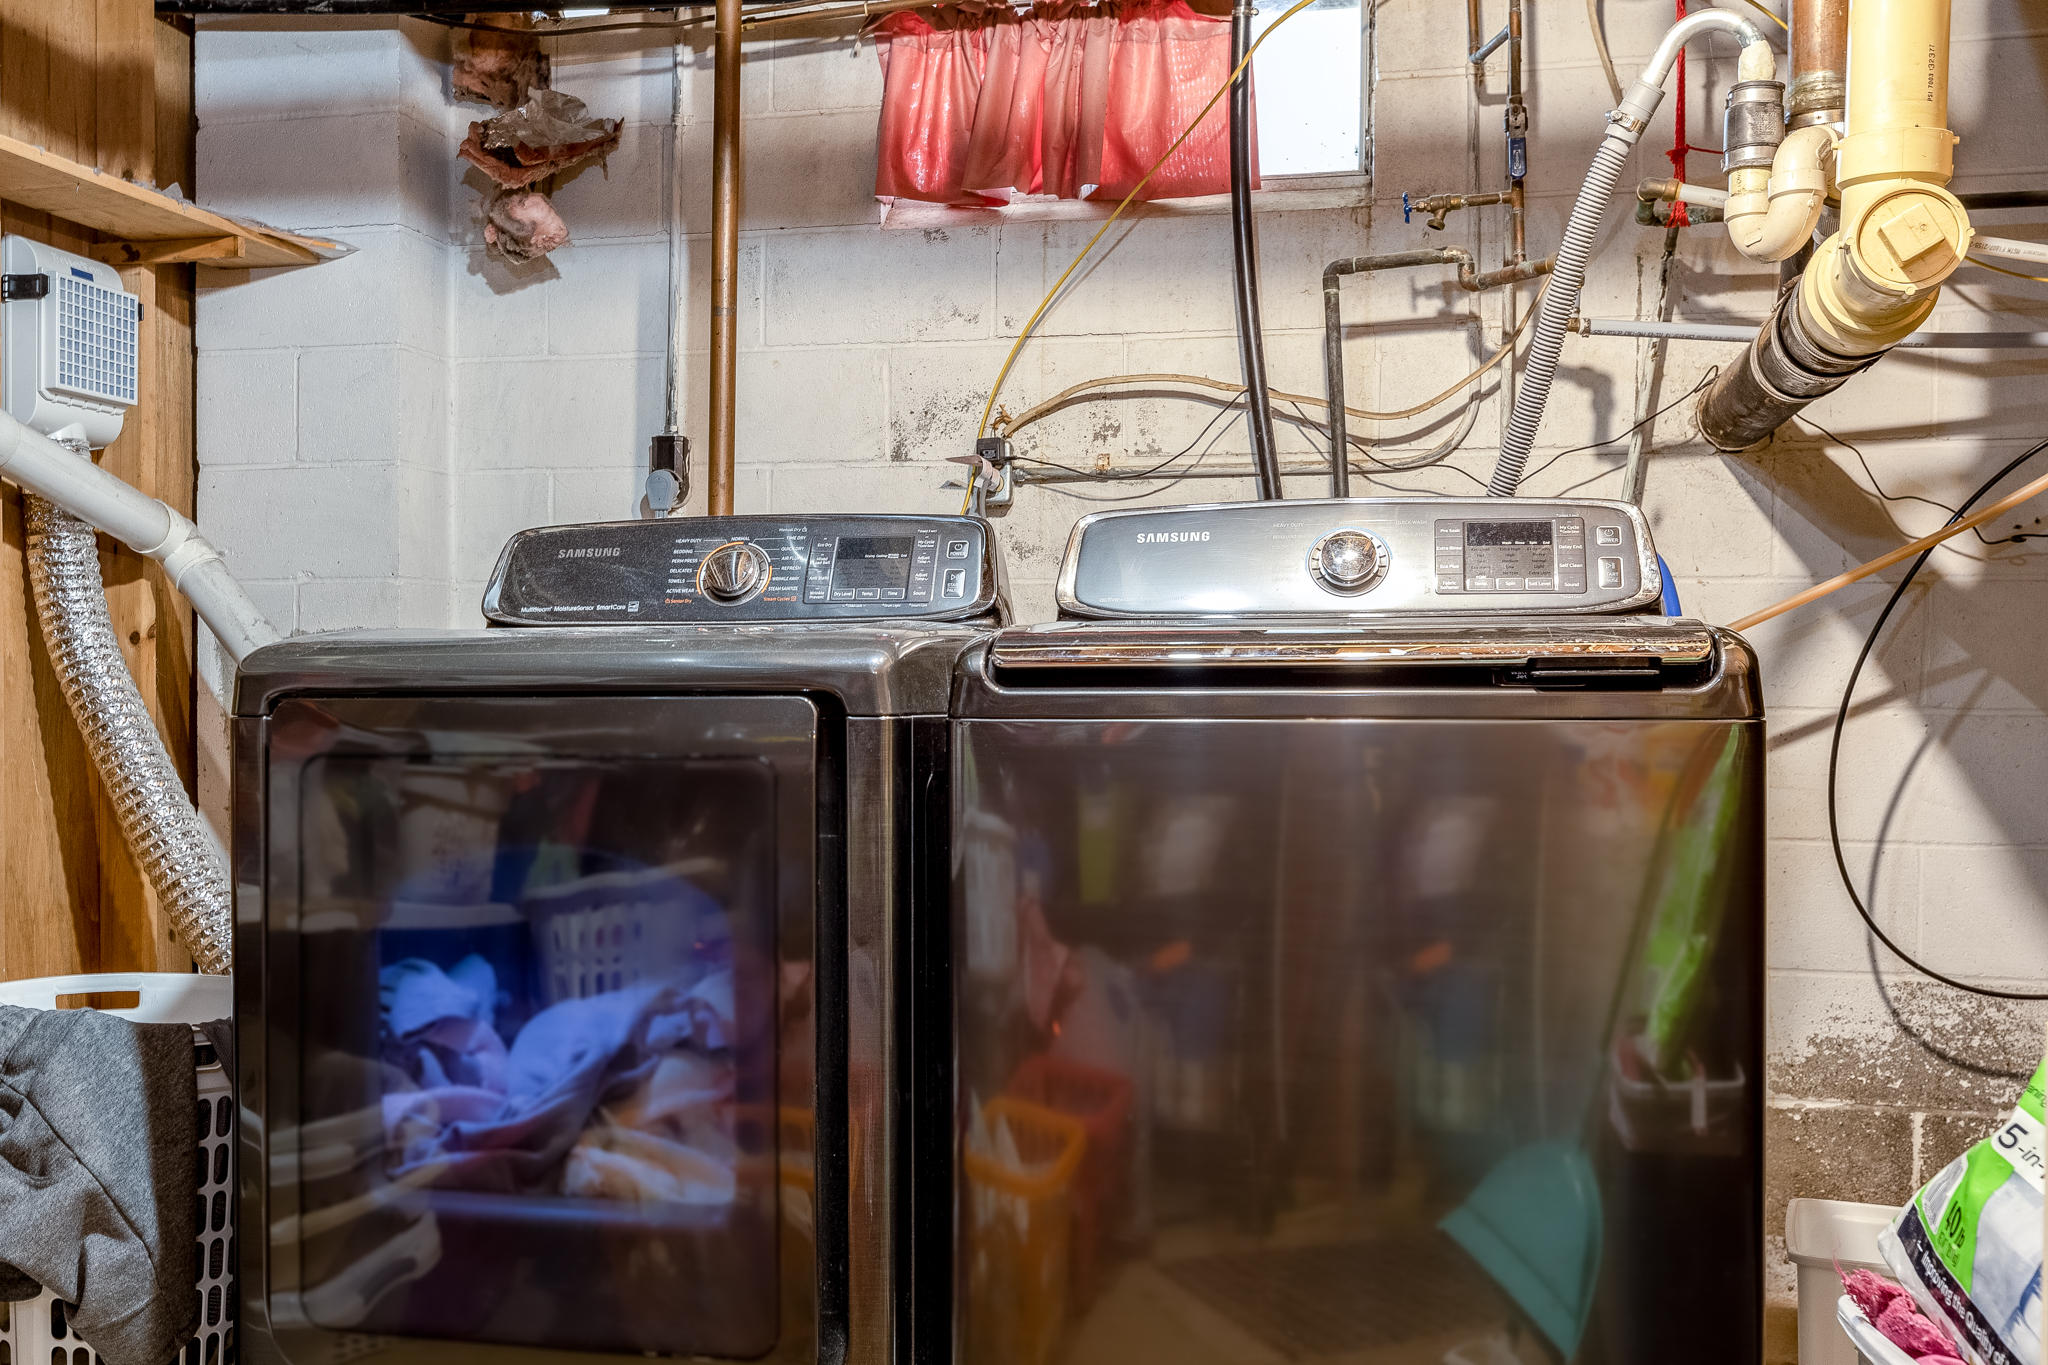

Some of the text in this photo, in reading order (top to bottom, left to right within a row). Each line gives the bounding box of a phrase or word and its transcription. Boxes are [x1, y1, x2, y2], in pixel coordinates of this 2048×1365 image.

[1136, 531, 1210, 544] SAMSUNG
[558, 547, 620, 559] SAMSUNG
[596, 603, 626, 611] SmartCare
[1998, 1123, 2046, 1179] 5-in-
[1945, 1201, 1962, 1238] 40
[1920, 1251, 1954, 1306] Improving
[1951, 1292, 1966, 1319] the
[1964, 1311, 1995, 1359] Quality
[1992, 1348, 2006, 1365] of
